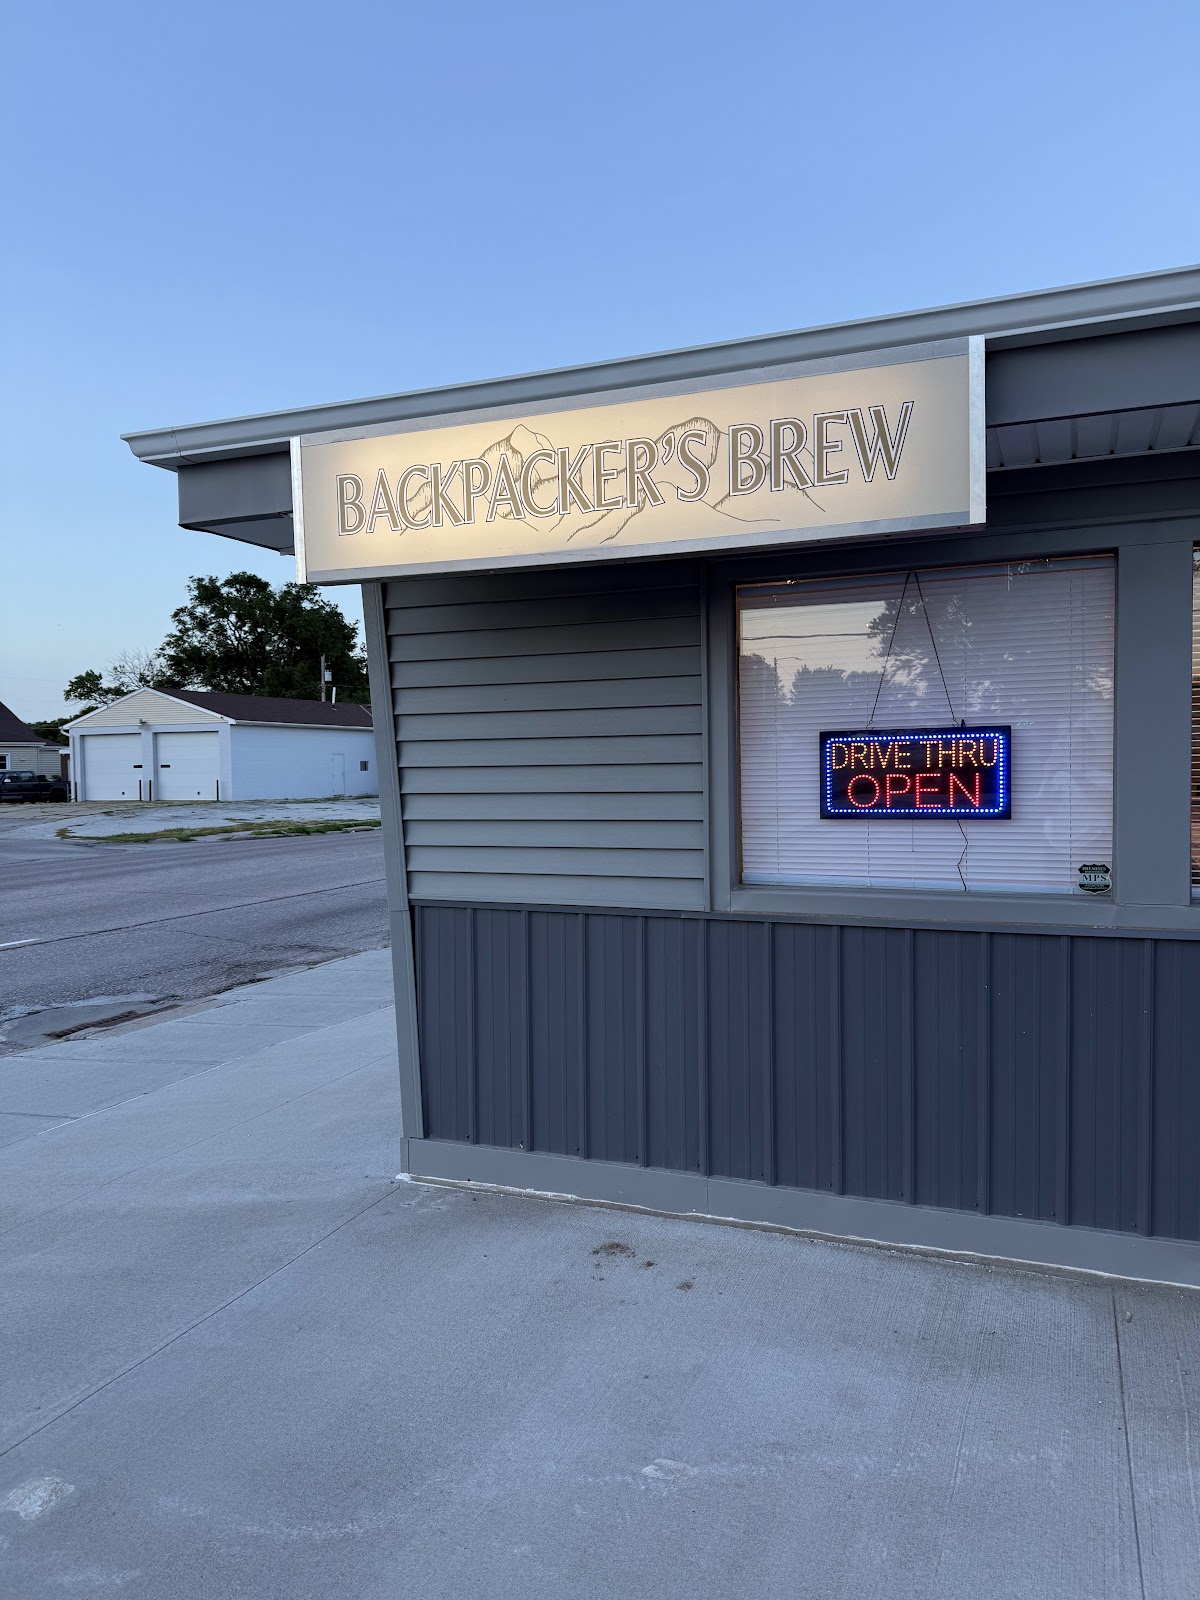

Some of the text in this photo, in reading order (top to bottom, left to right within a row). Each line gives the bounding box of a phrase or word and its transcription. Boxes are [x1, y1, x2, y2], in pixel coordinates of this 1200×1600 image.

[336, 401, 914, 536] BACKPACKER'S BREW
[831, 739, 998, 769] DRIVE THRU
[847, 773, 980, 808] OPEN
[1082, 874, 1107, 882] MPS
